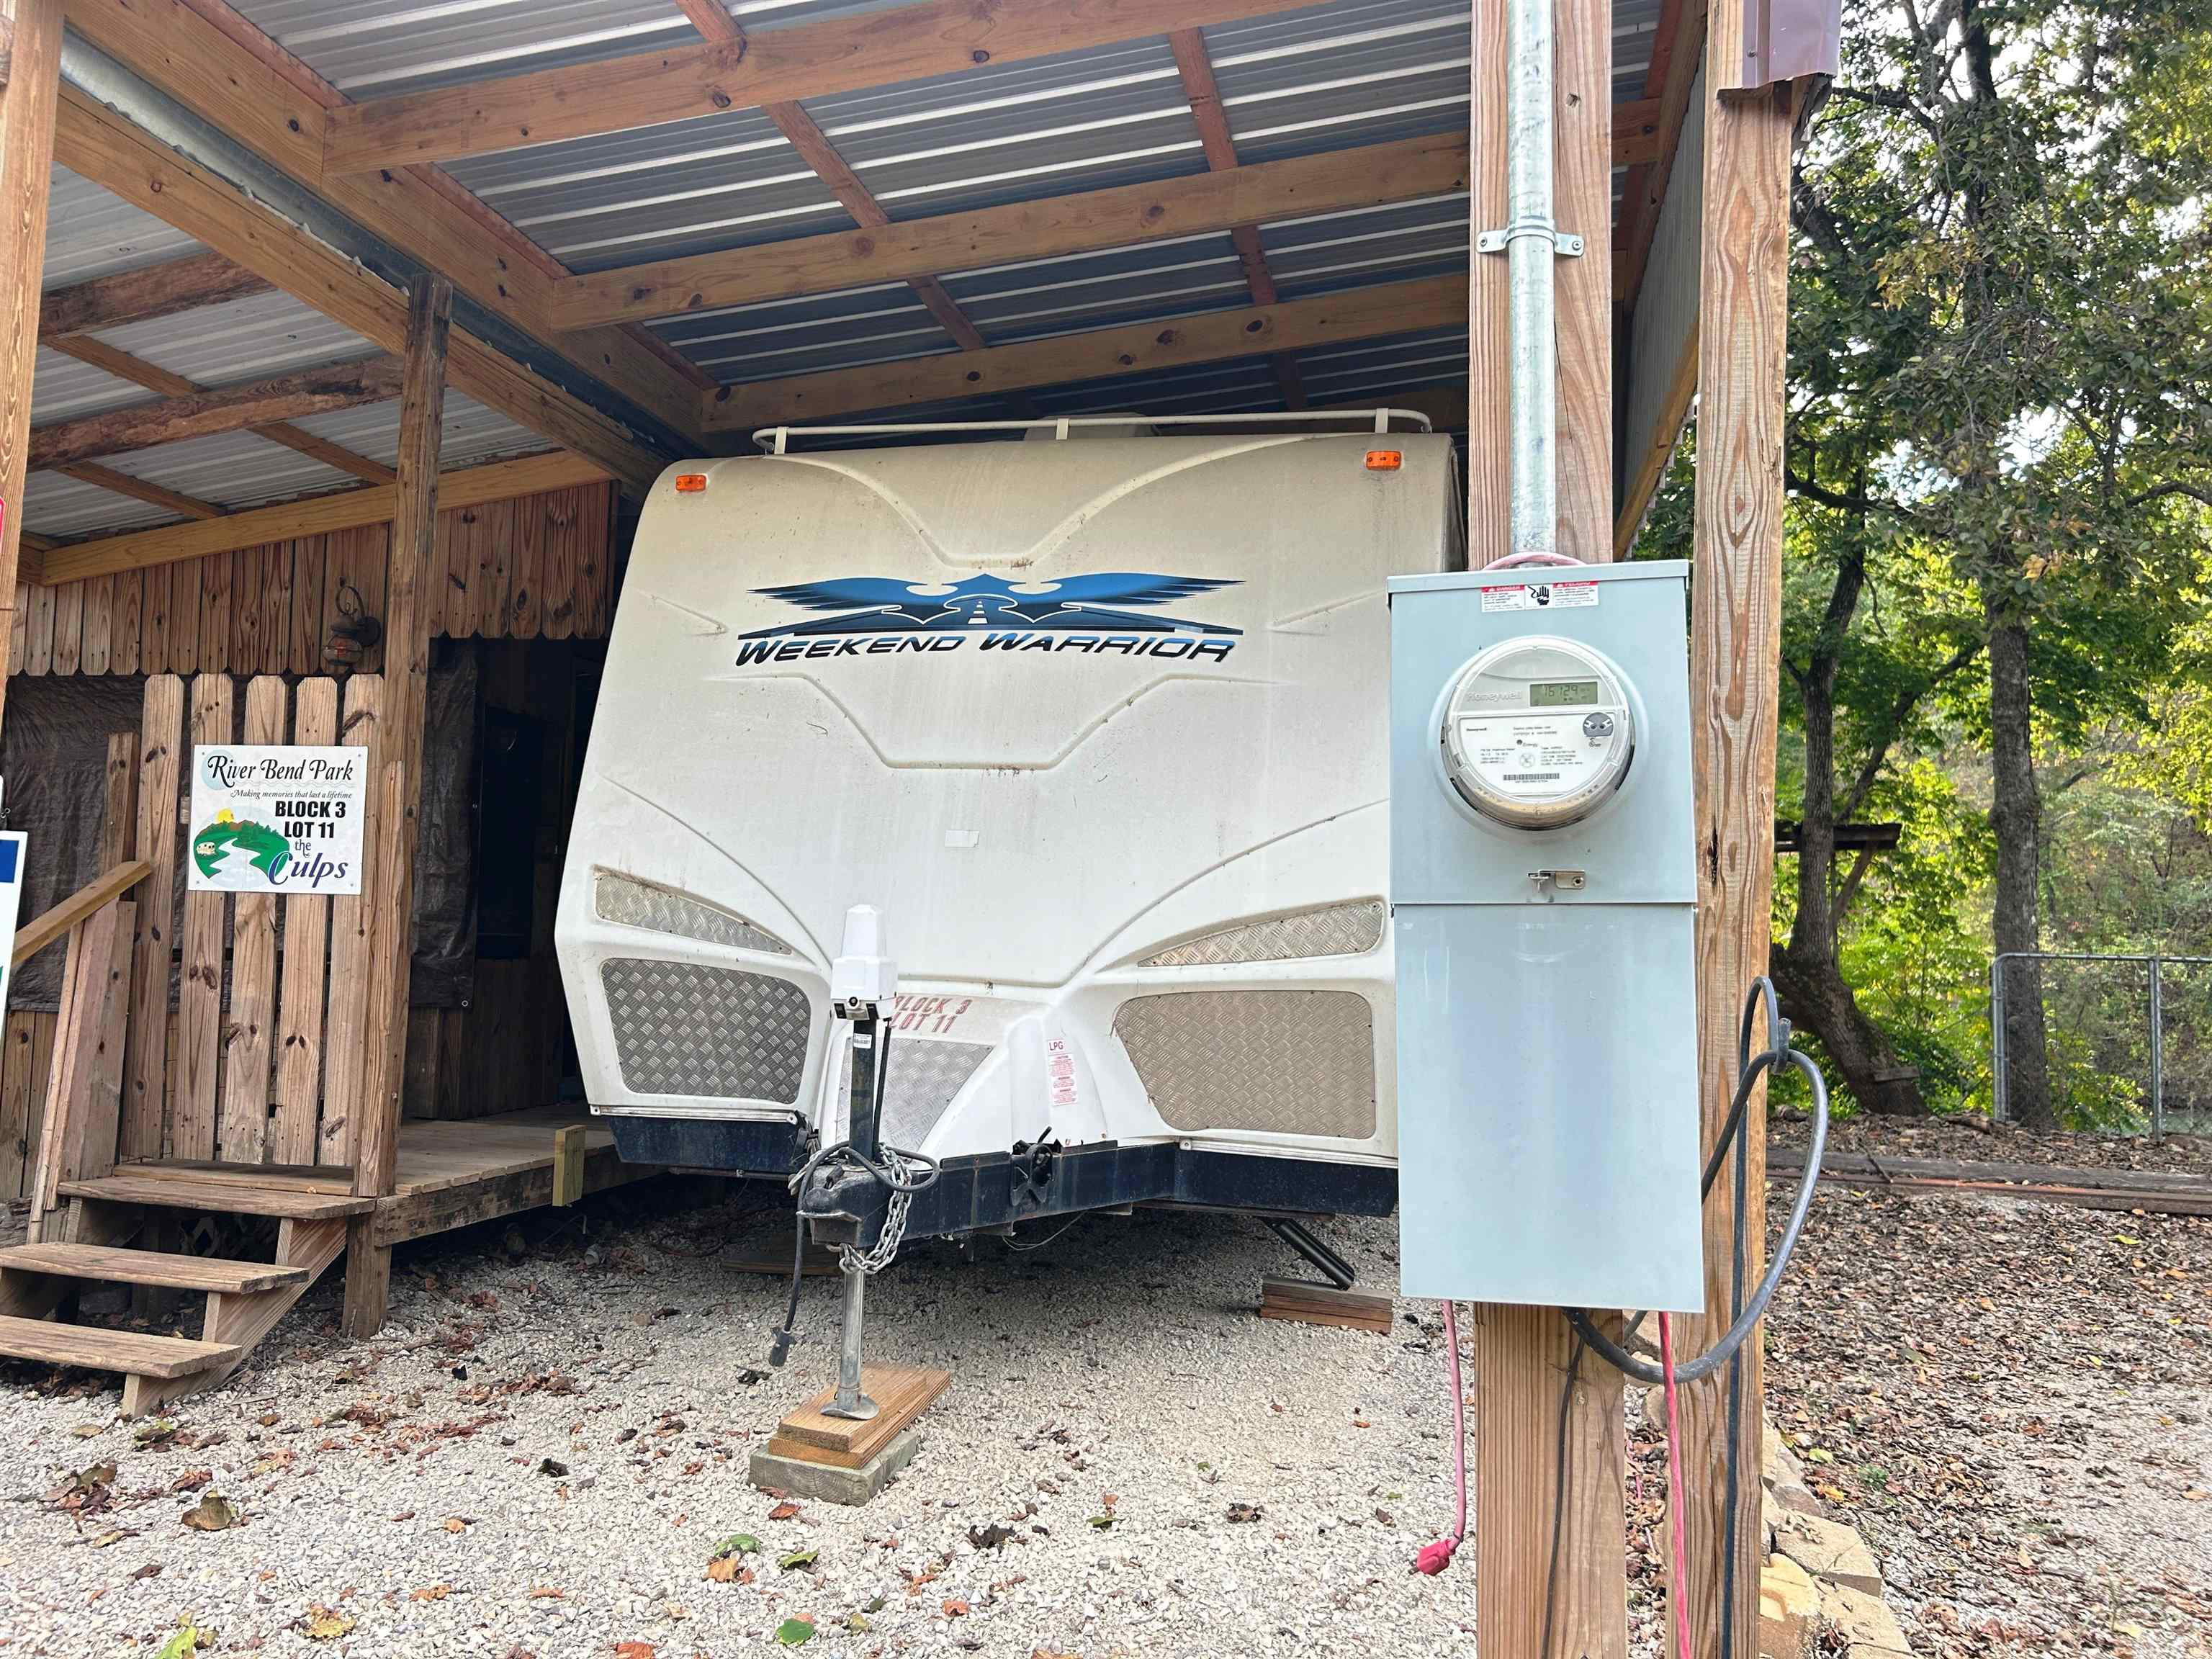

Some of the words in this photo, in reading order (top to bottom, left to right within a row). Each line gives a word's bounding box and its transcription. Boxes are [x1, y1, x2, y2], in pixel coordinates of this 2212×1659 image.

[735, 636, 967, 666] WEEKEND
[979, 633, 1236, 662] WARRIOR
[207, 755, 256, 788] River
[260, 759, 306, 780] Bend
[309, 759, 353, 781] Park
[230, 790, 261, 799] Making
[275, 801, 331, 818] BLOCK
[335, 801, 346, 818] 3
[284, 821, 315, 837] LOT
[318, 822, 335, 838] 11
[295, 839, 311, 857] the
[269, 852, 349, 889] Culps
[956, 999, 973, 1015] 3
[891, 1012, 932, 1030] LOT
[931, 1015, 958, 1033] 11
[1049, 1041, 1064, 1051] LPG
